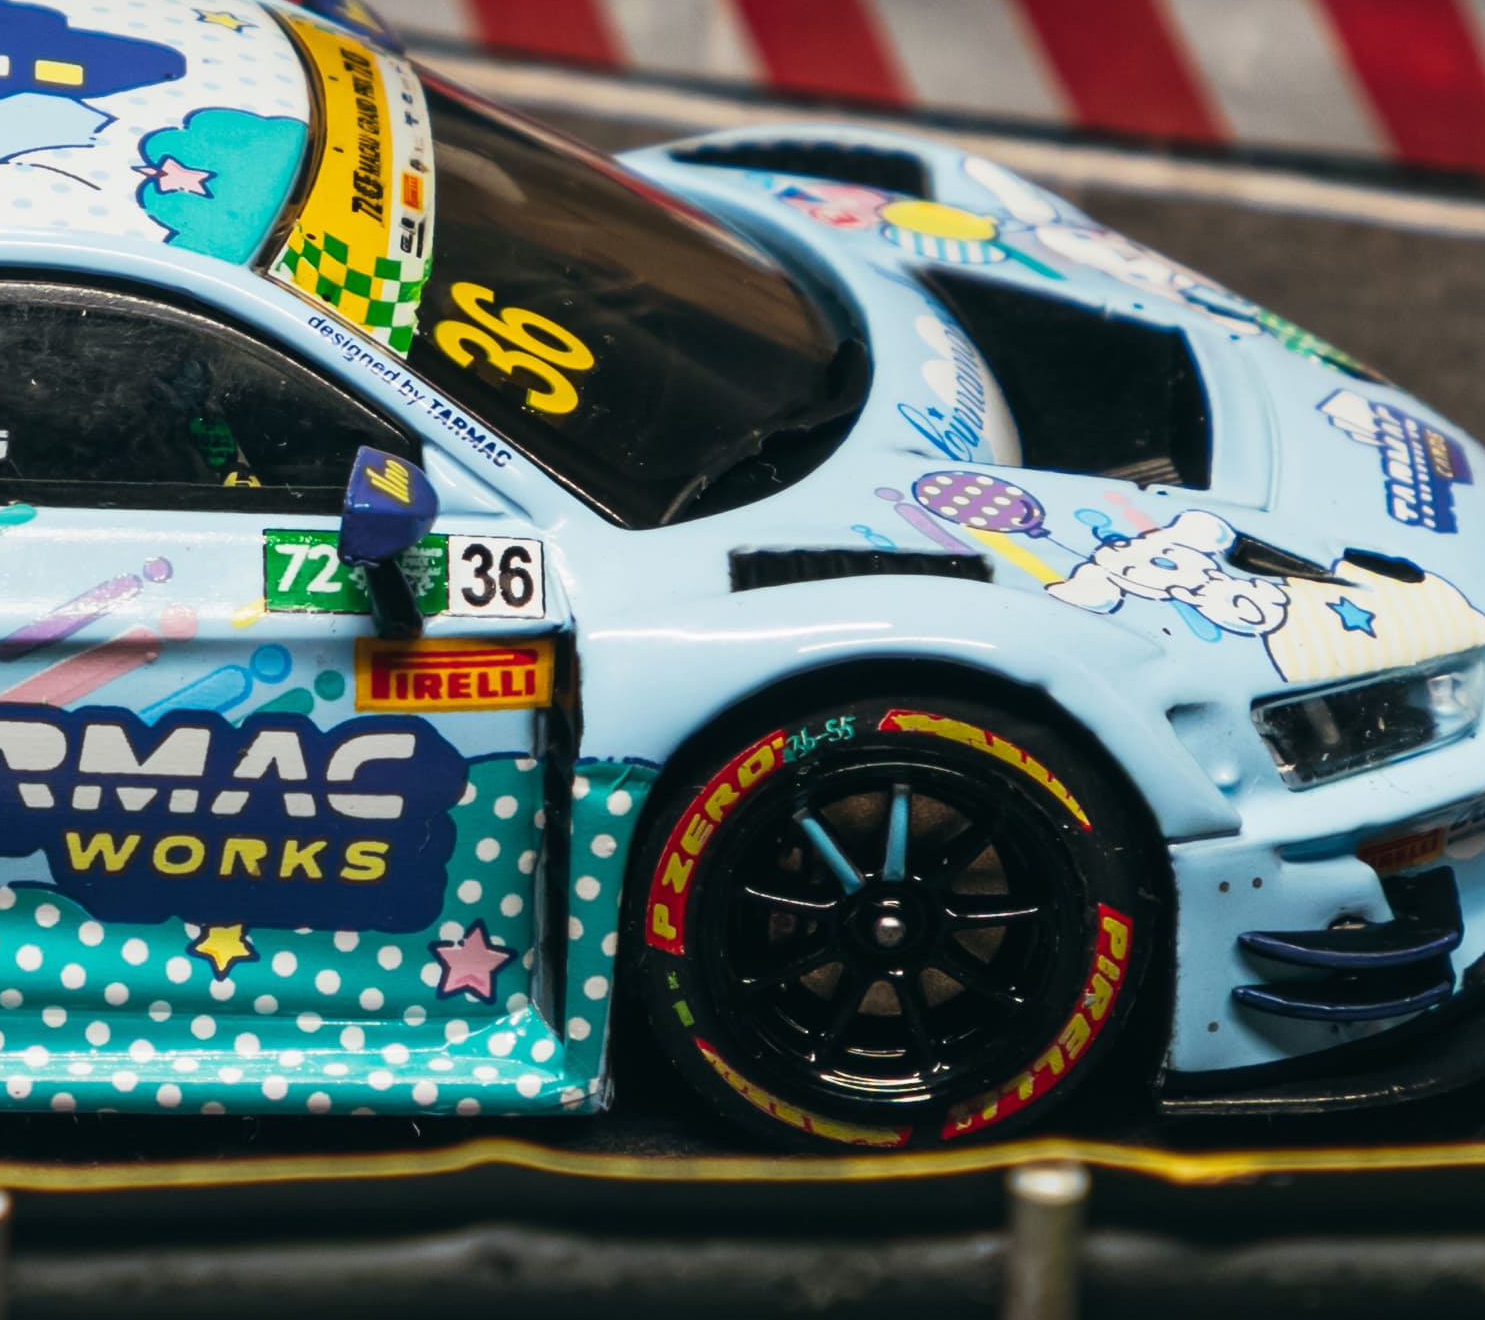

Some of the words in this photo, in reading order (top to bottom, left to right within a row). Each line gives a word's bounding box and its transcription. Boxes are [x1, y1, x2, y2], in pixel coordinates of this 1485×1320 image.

[434, 281, 594, 414] 36
[307, 315, 401, 386] designed
[397, 379, 425, 406] by
[426, 397, 513, 468] TARMAC
[274, 543, 343, 593] 72
[461, 543, 534, 607] 36
[371, 649, 539, 700] PIRELLI
[65, 831, 392, 882] WORKS
[652, 902, 678, 941] P
